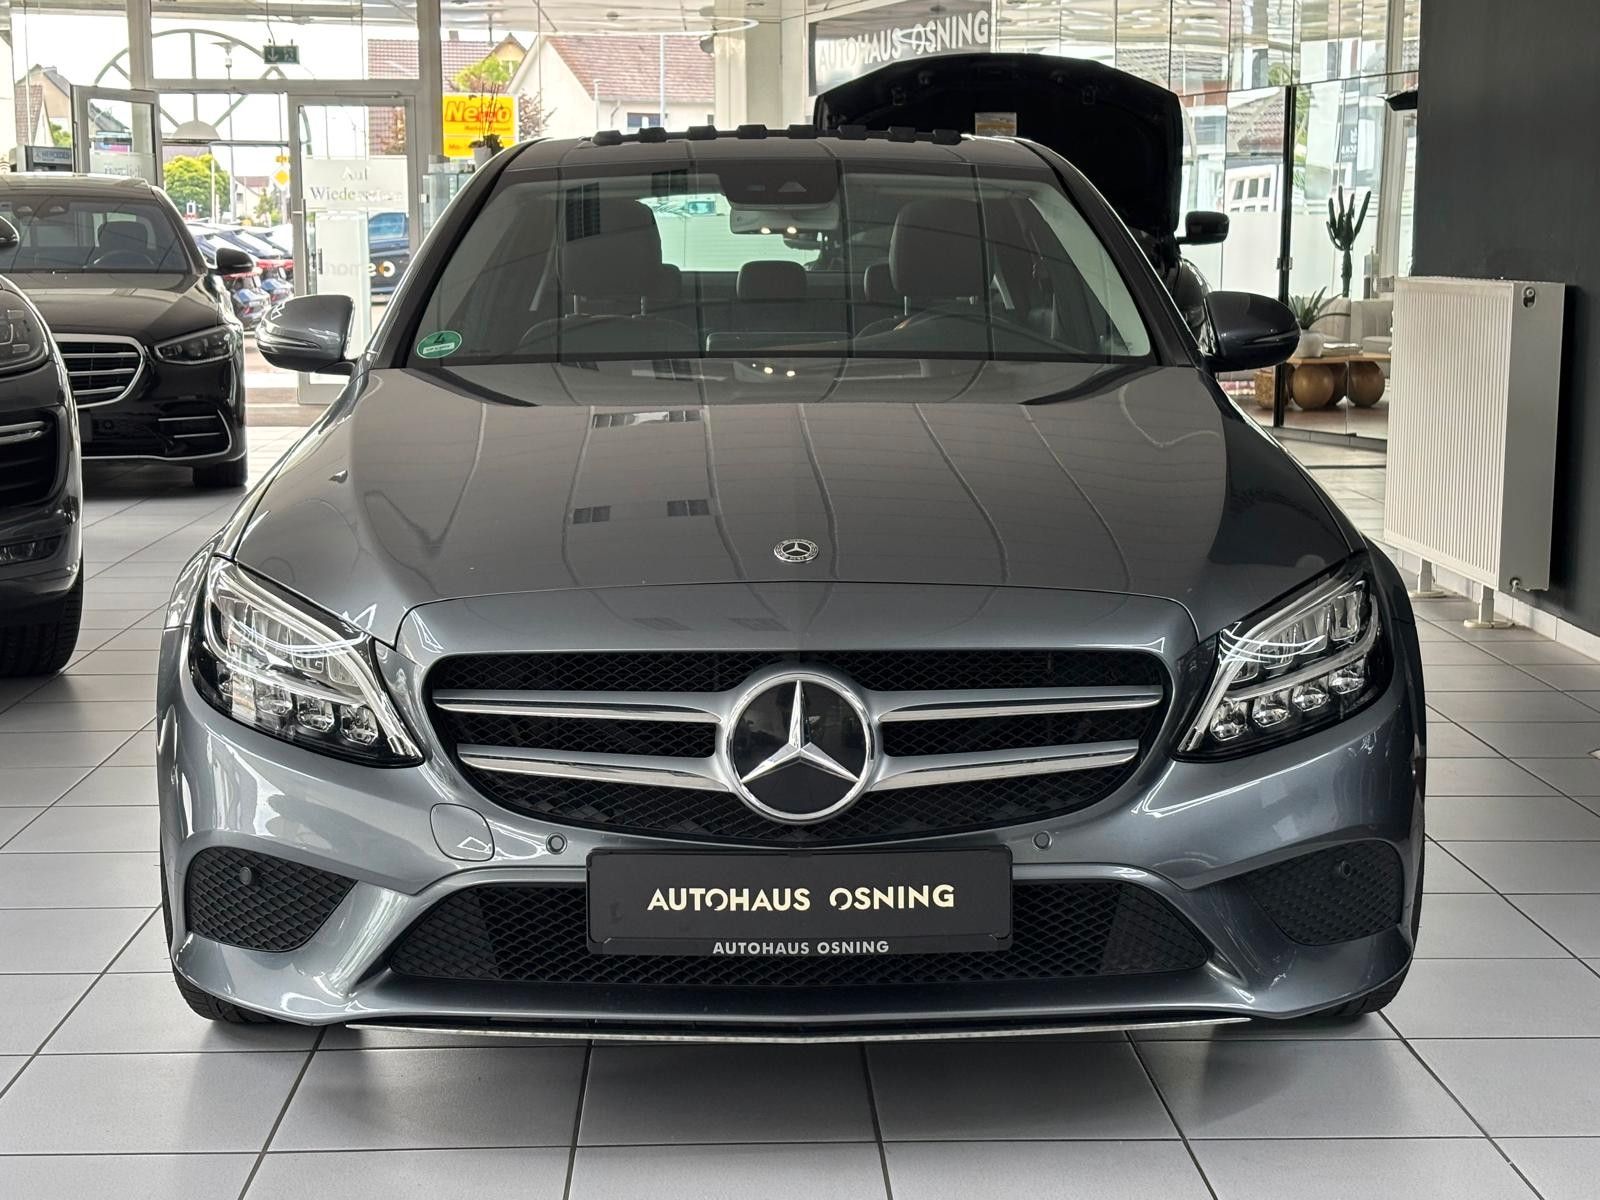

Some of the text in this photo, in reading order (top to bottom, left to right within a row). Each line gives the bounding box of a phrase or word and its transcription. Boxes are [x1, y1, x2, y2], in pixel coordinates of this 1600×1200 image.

[818, 9, 989, 72] AUTOHAUS OSNING
[646, 883, 955, 912] AUTOHAUS OSNING
[712, 940, 889, 955] AUTOHAUS OSNING
